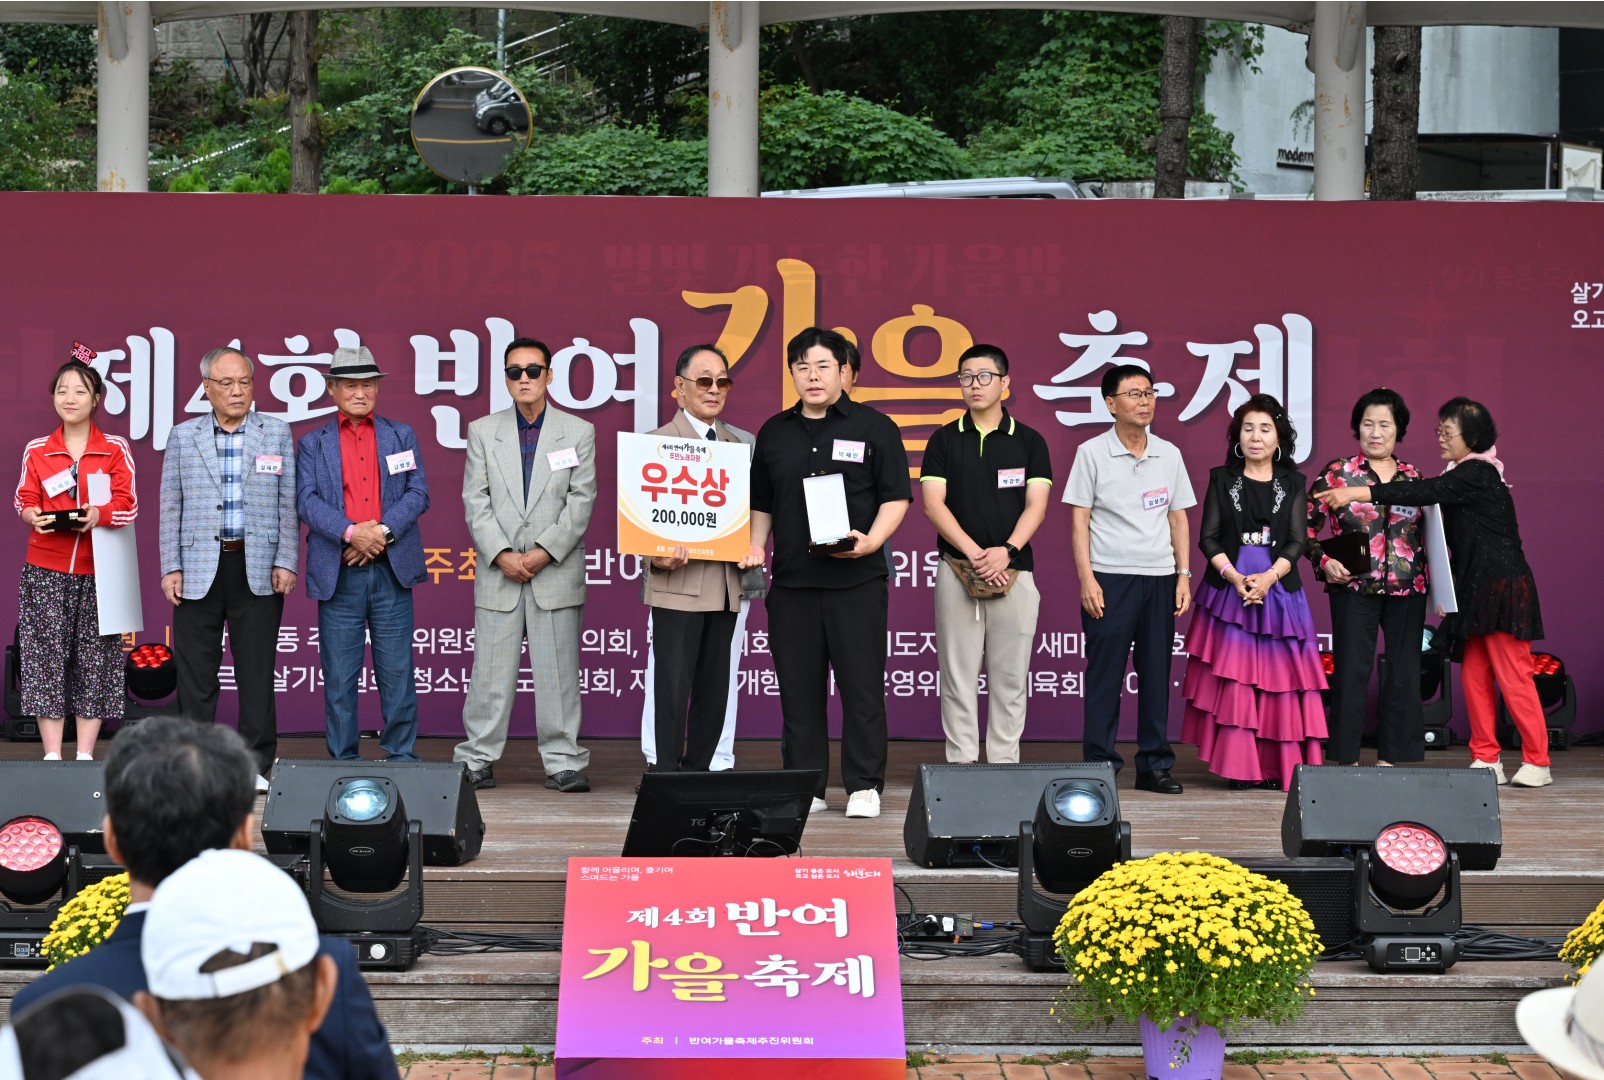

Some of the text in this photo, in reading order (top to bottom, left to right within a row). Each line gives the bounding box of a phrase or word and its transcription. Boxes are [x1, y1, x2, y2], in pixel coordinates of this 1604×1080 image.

[409, 316, 659, 449] 반여
[1032, 309, 1313, 464] 축제
[683, 442, 695, 454] 가을
[641, 462, 730, 508] 우수상
[652, 508, 717, 529] 200,000원
[581, 866, 599, 874] 함께
[646, 866, 674, 874] 즐기며
[626, 897, 848, 938] 제4회 반여
[582, 940, 876, 1002] 가을 축제
[641, 1036, 814, 1046] 주최 반여가을축제추진위원회
